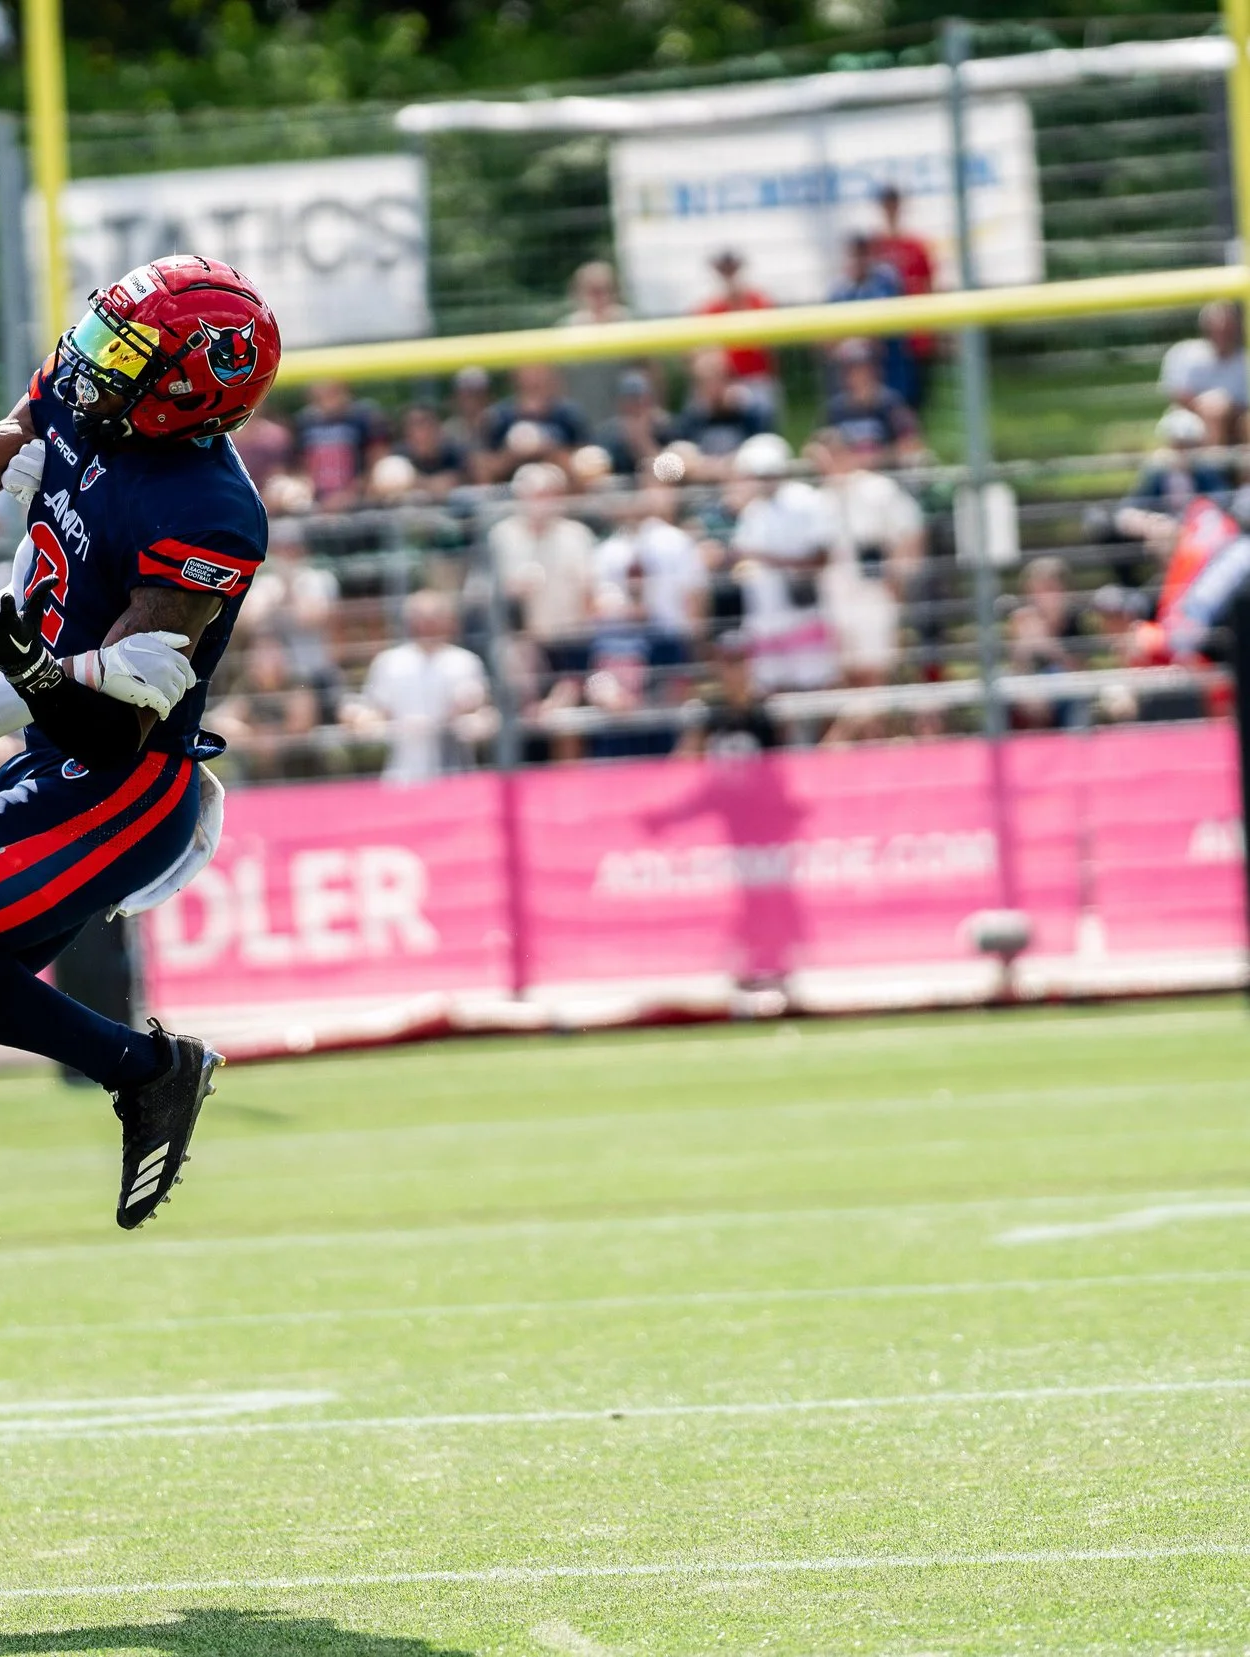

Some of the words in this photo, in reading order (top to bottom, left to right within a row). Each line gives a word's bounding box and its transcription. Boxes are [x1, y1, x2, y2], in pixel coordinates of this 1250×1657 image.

[187, 564, 207, 576] LEAGUE
[189, 560, 218, 574] EUROPEAN
[184, 570, 211, 583] FOOTBALL
[151, 844, 441, 966] DLER
